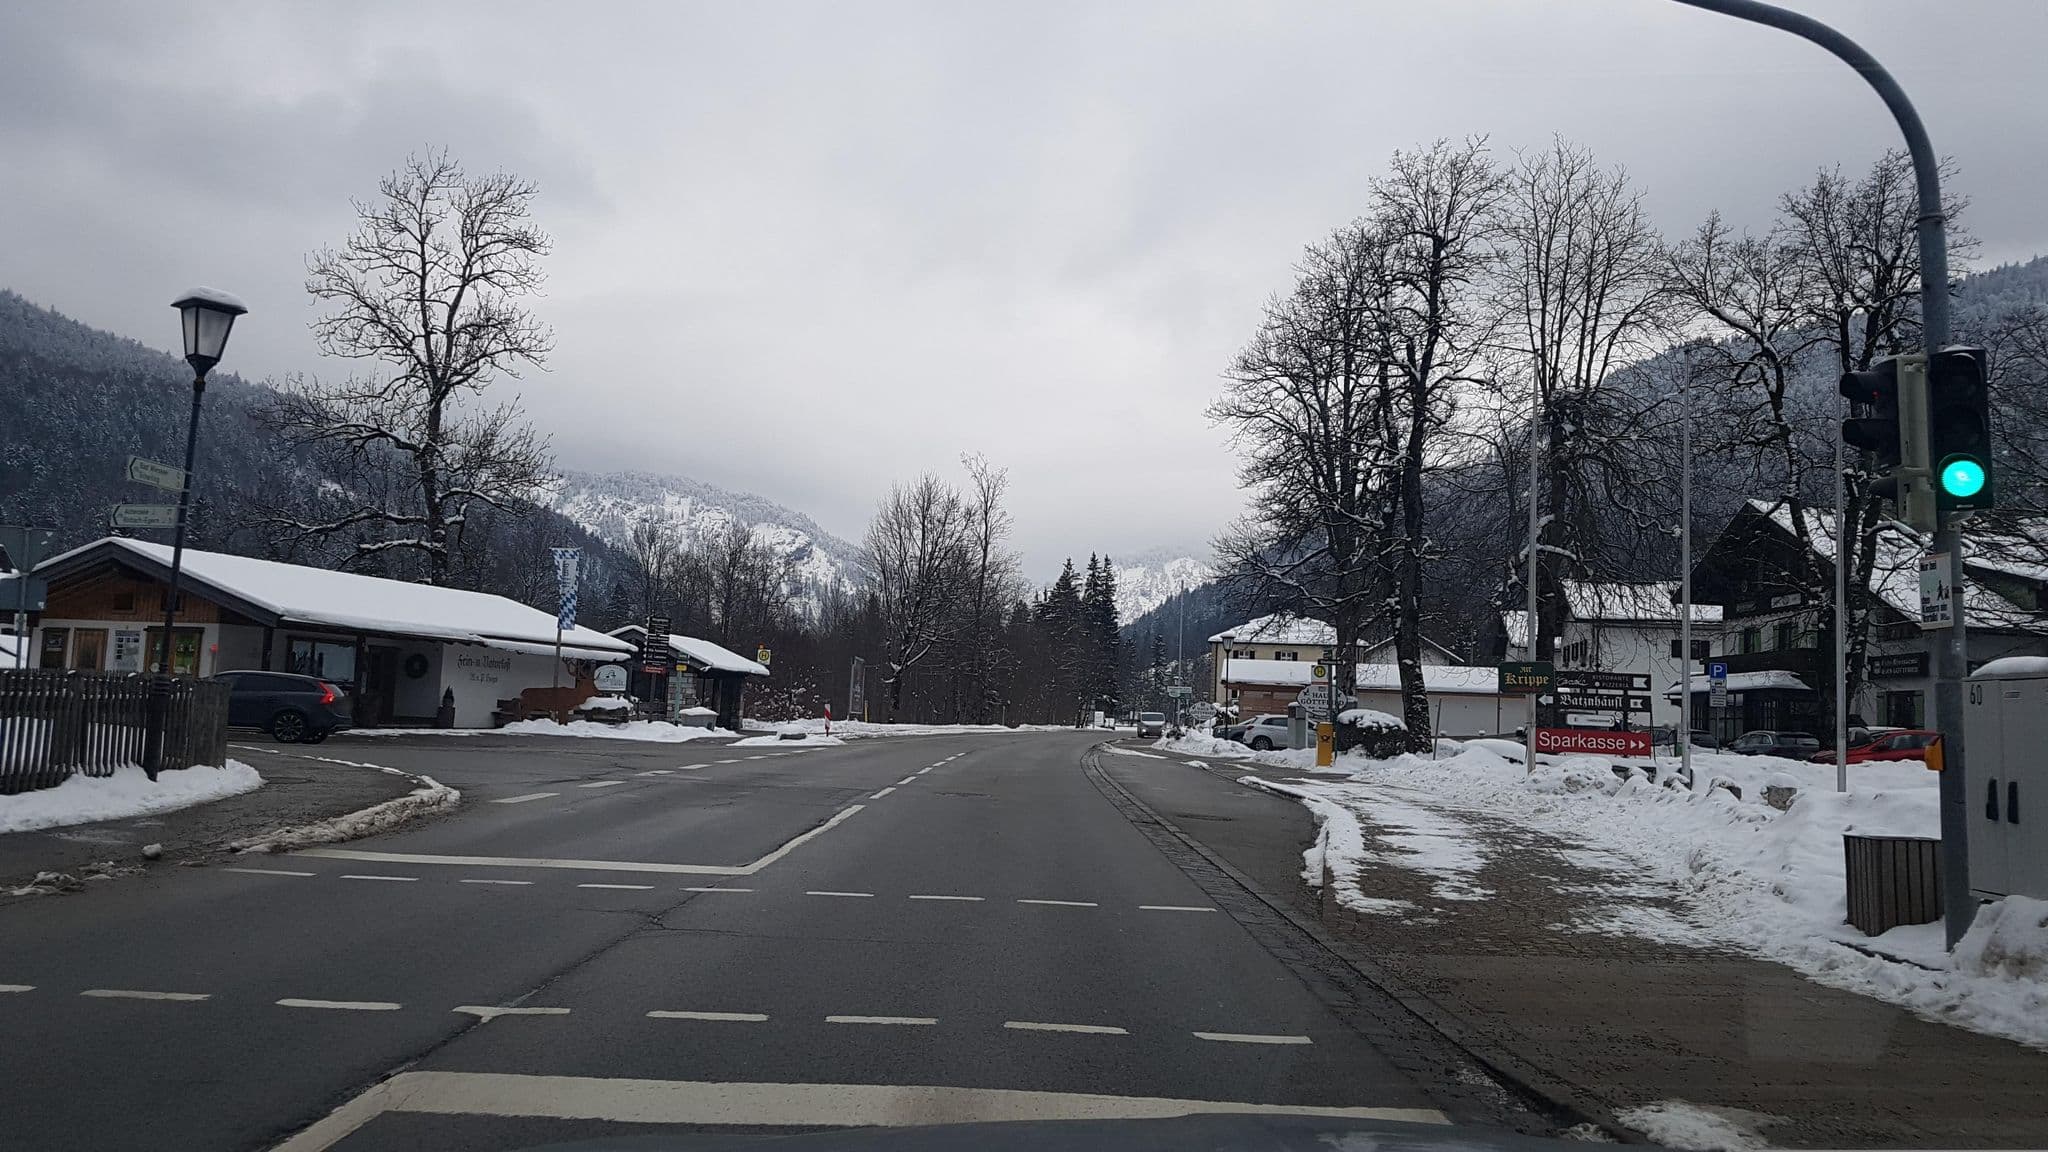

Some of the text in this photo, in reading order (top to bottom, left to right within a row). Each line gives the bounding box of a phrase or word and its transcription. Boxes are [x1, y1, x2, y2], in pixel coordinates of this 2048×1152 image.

[1504, 672, 1549, 687] Krippe
[1713, 665, 1723, 677] P
[1970, 684, 1982, 705] 60
[1538, 731, 1626, 750] Sparkasse
